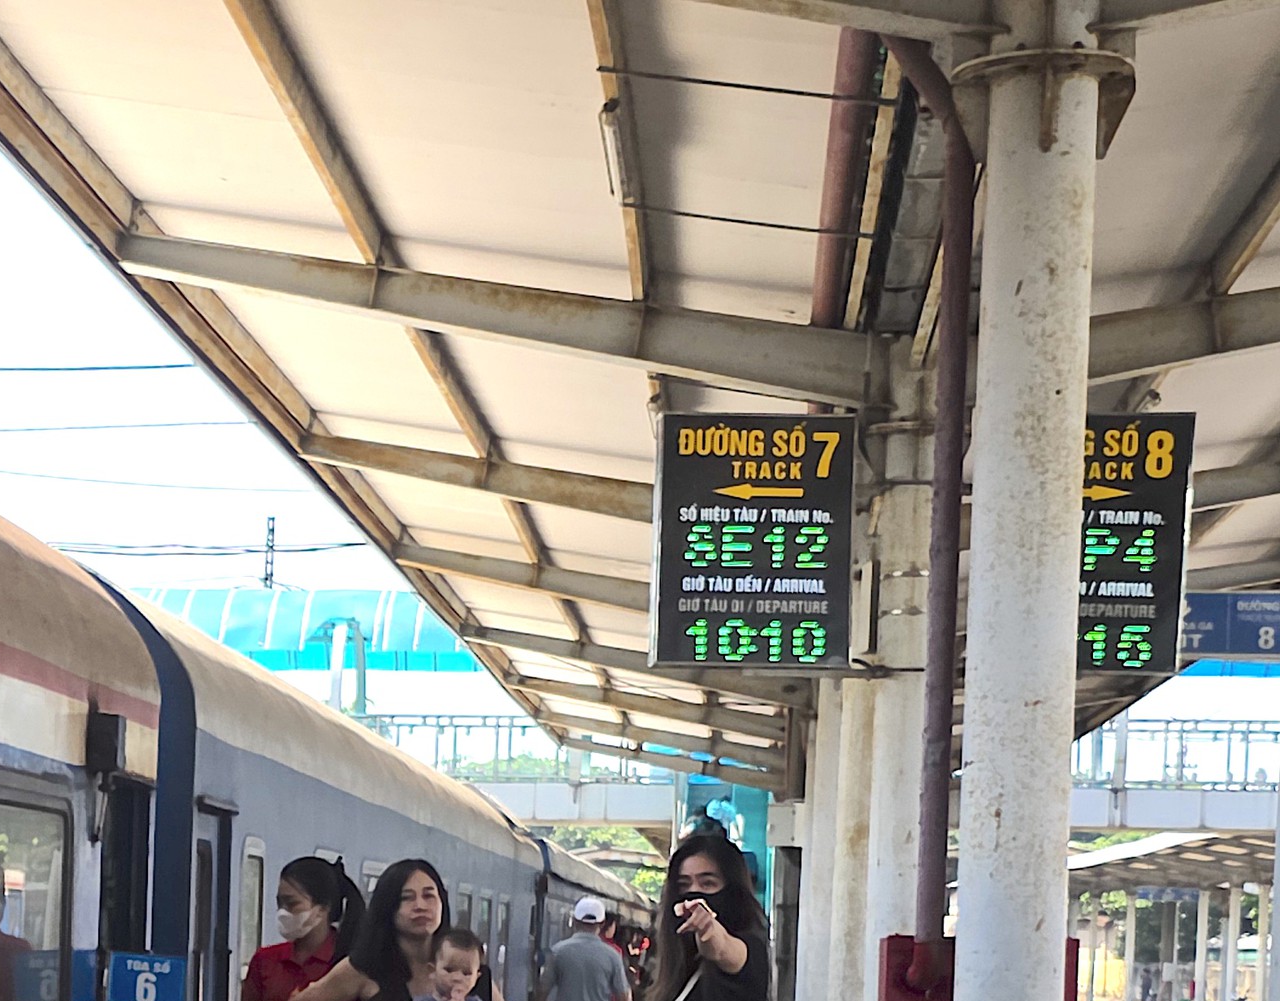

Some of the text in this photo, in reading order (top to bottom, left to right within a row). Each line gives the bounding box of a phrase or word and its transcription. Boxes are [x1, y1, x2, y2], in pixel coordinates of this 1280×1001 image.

[678, 421, 840, 478] ĐƯỜNG SỐ 7
[1102, 420, 1140, 457] SỐ
[1145, 430, 1174, 479] 8
[731, 461, 802, 480] TRACK
[1088, 461, 1134, 480] ACK
[679, 504, 697, 522] SỐ
[733, 506, 758, 523] TÀU
[771, 508, 809, 524] TRAIN
[1099, 510, 1140, 525] TRAIN
[1083, 528, 1158, 572] P4
[708, 575, 732, 593] TÀU
[773, 578, 826, 594] ARRIVAL
[1098, 581, 1154, 597] ARRIVAL
[704, 597, 727, 614] TÀU
[756, 600, 829, 615] DEPARTURE
[1080, 603, 1156, 619] DEPARTURE
[1258, 626, 1275, 649] 8
[127, 959, 150, 971] TOA
